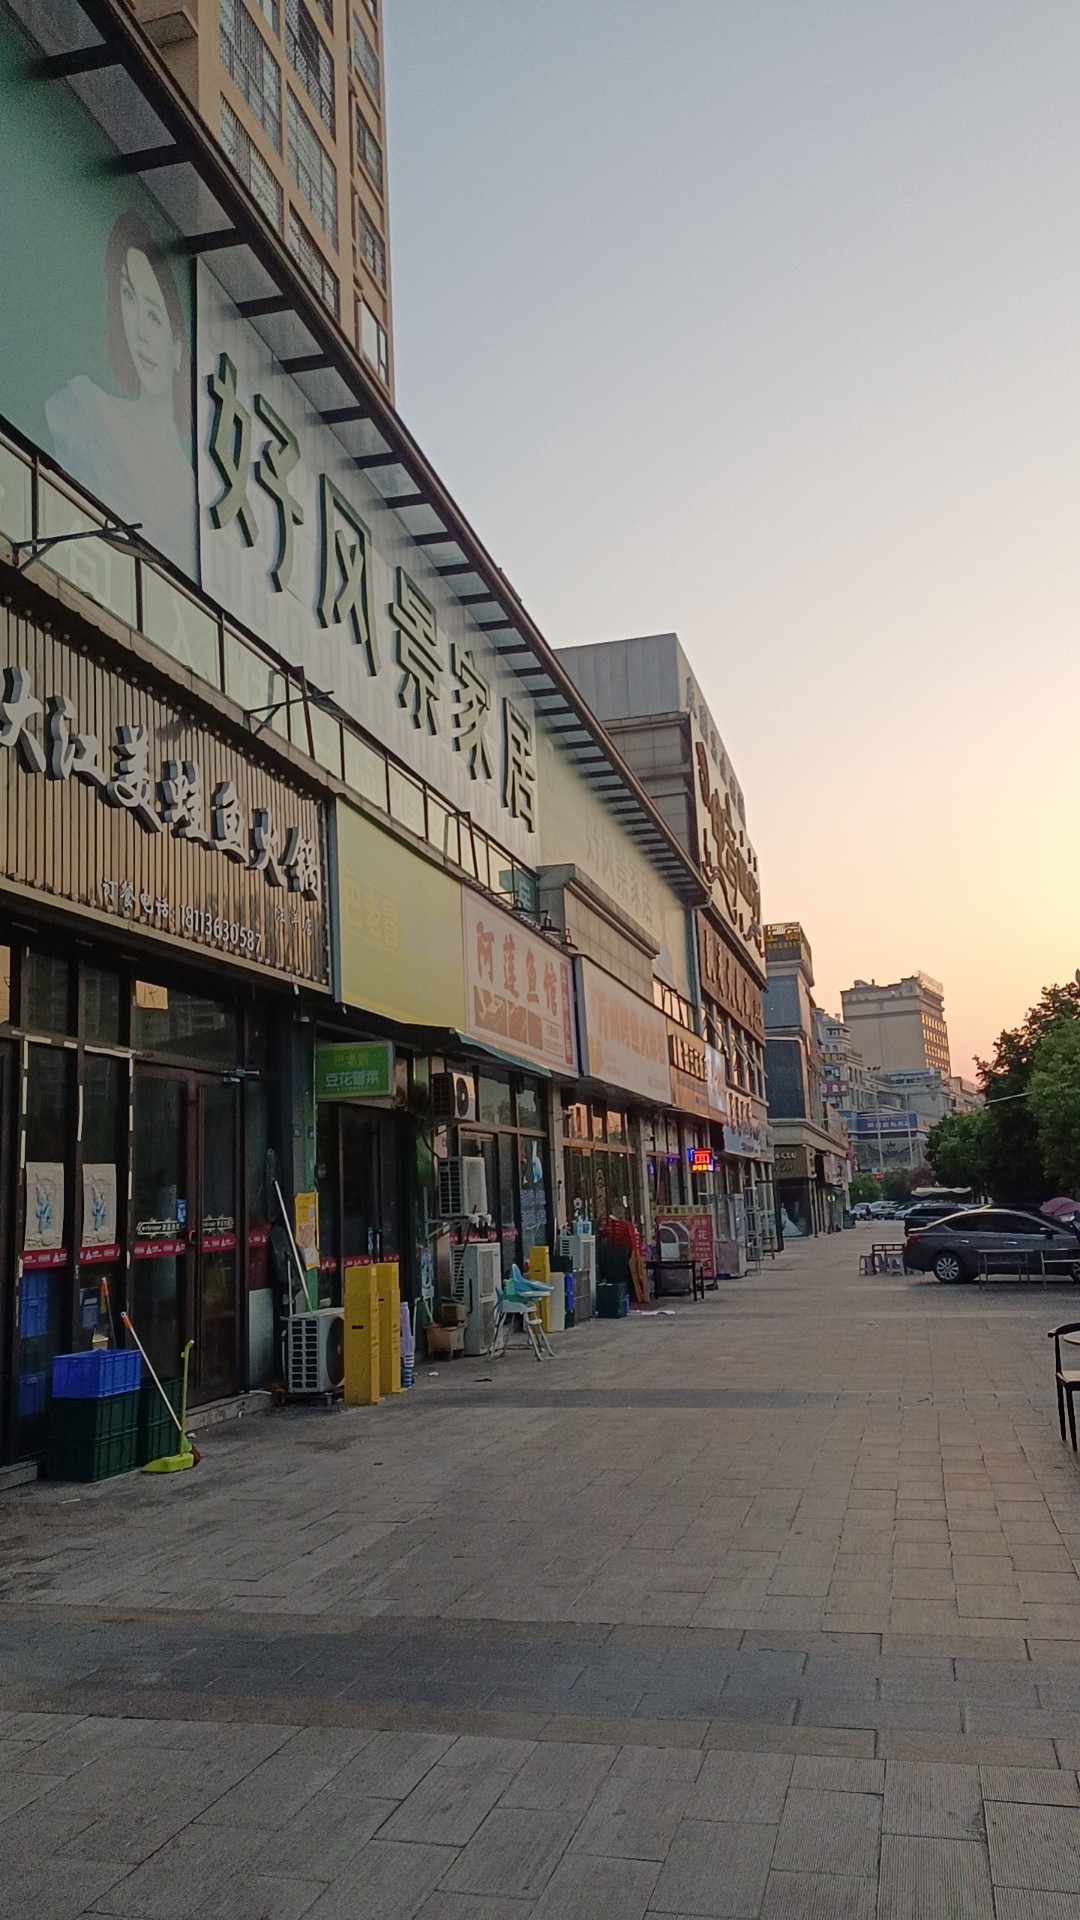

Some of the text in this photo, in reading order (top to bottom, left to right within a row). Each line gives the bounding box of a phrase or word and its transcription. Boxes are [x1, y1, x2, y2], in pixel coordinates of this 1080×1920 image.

[207, 352, 536, 833] 好风景家居
